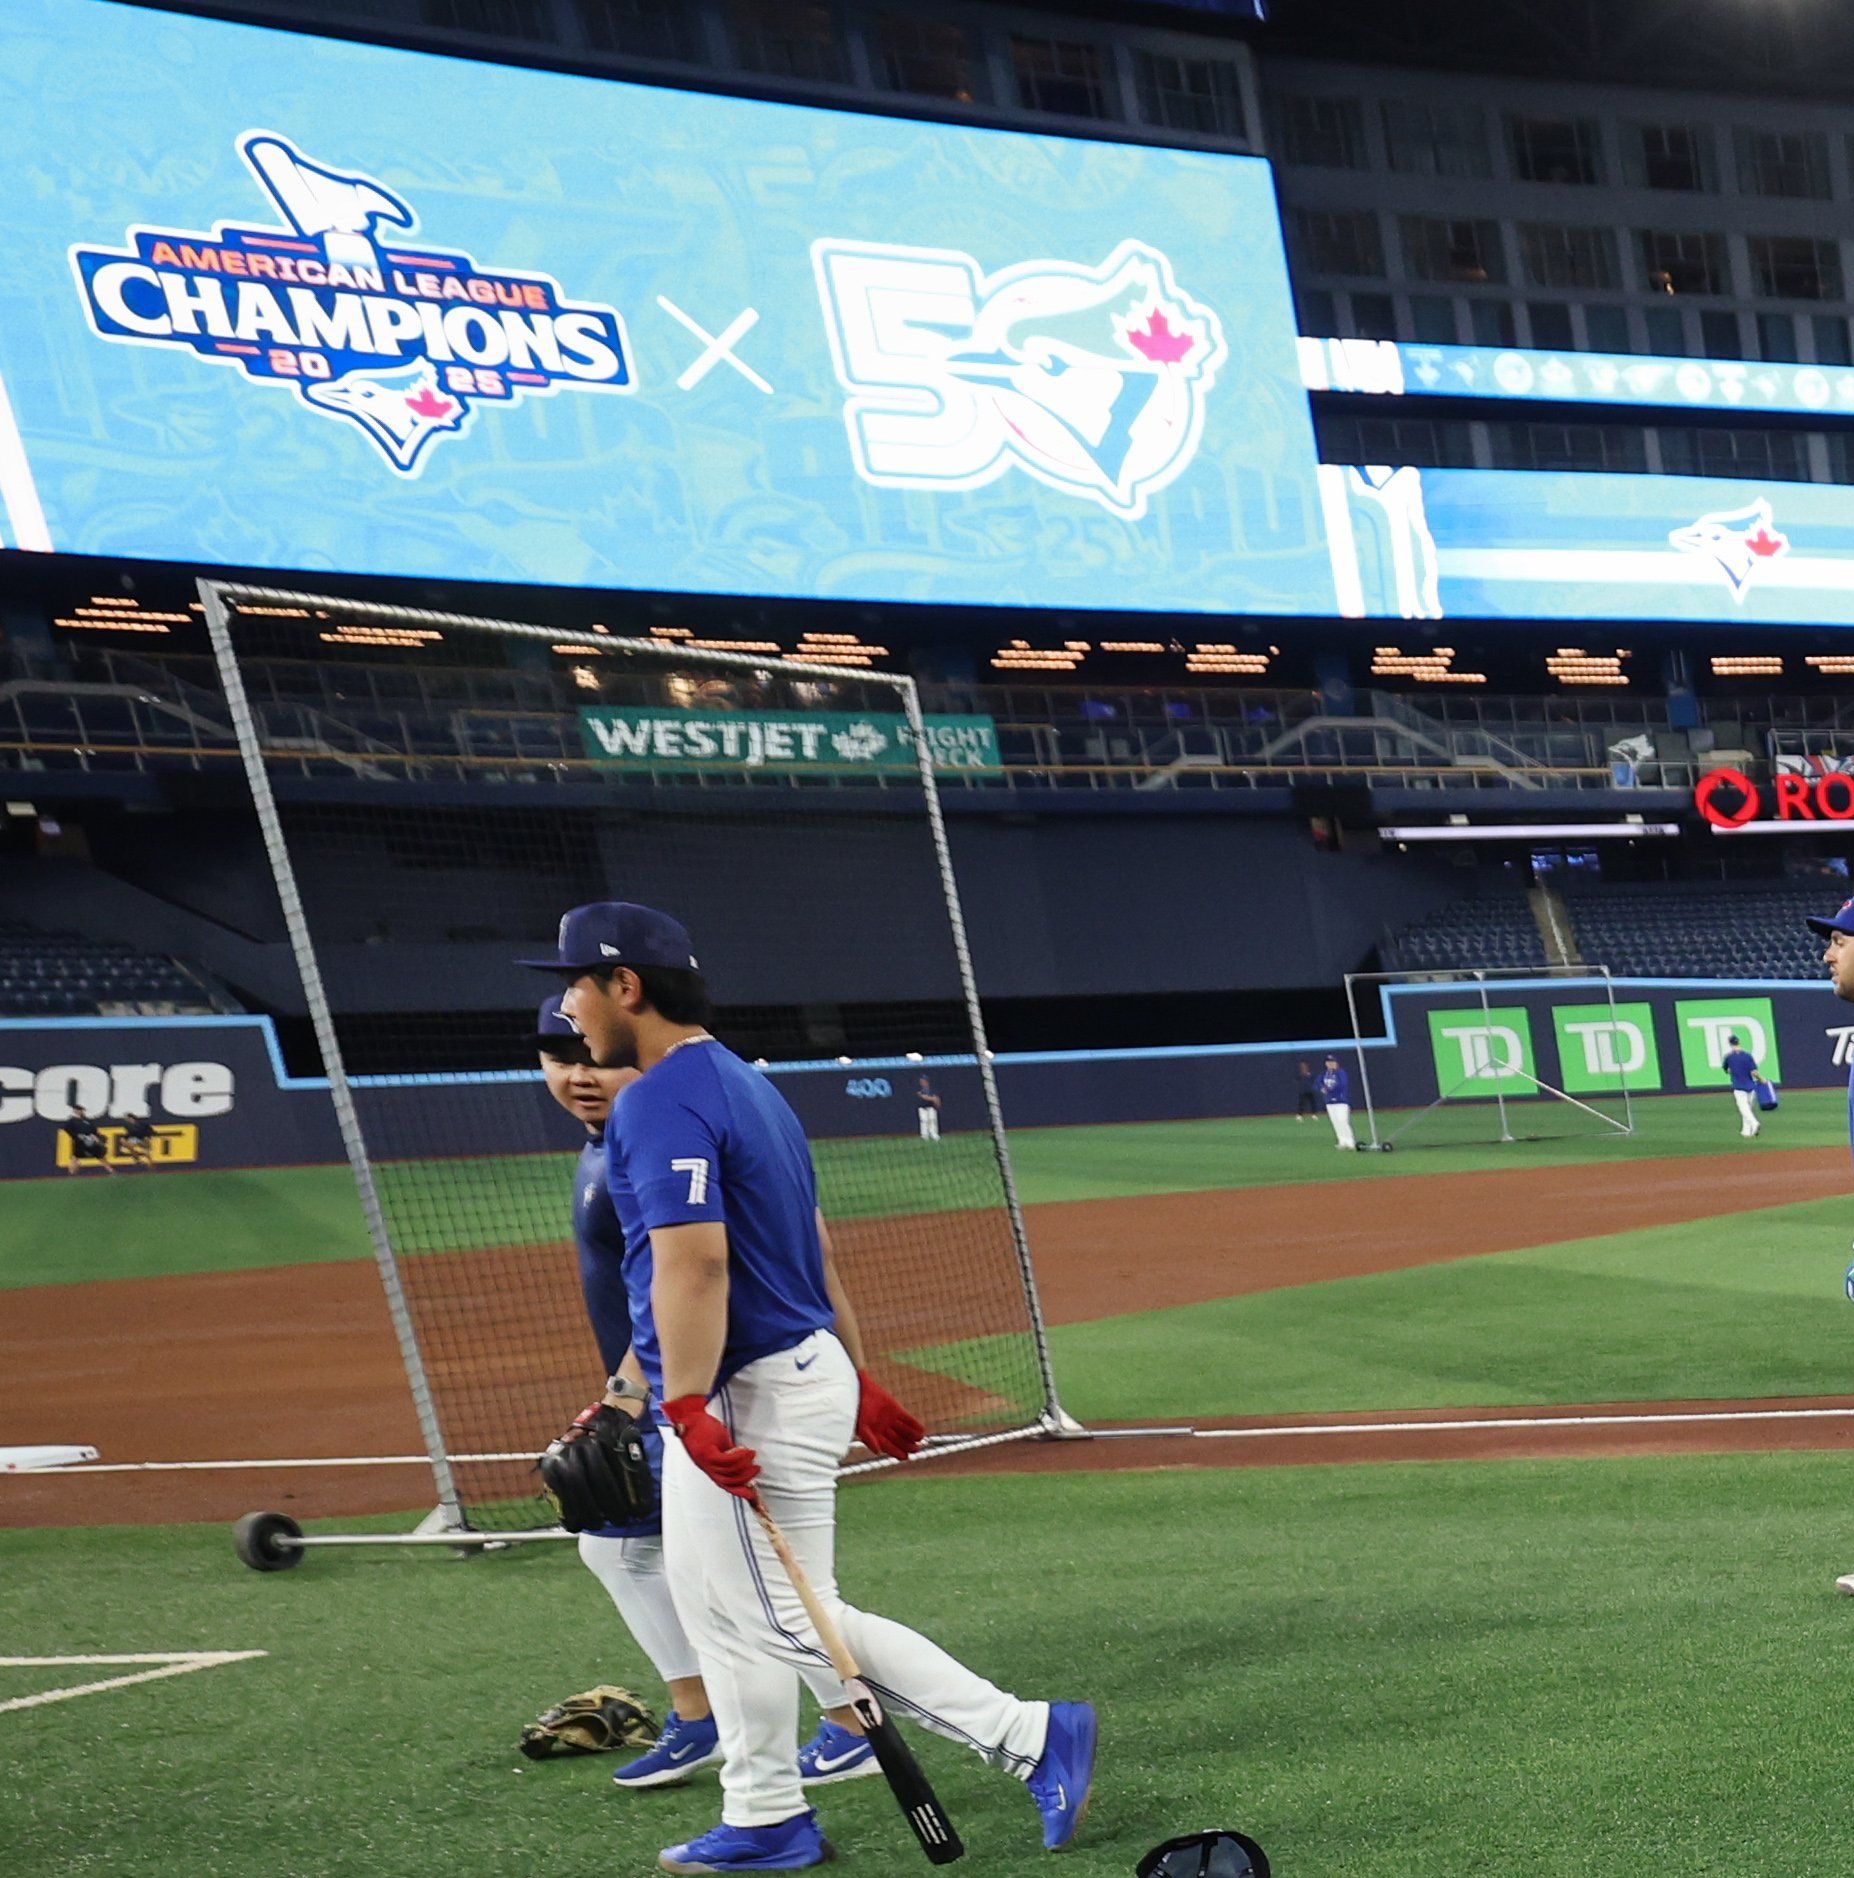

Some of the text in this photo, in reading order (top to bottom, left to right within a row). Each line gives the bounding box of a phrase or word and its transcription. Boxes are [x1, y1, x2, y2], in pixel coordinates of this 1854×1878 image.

[151, 240, 550, 312] AMERICAN LEAGUE
[90, 261, 621, 381] CHAMPIONS
[269, 347, 505, 396] 20 25
[588, 716, 827, 766] WESTJET
[1440, 1026, 1525, 1079] TD
[1564, 1020, 1647, 1075] TD
[1686, 1015, 1767, 1070] TD
[845, 1077, 893, 1100] 400
[670, 1157, 711, 1205] 7
